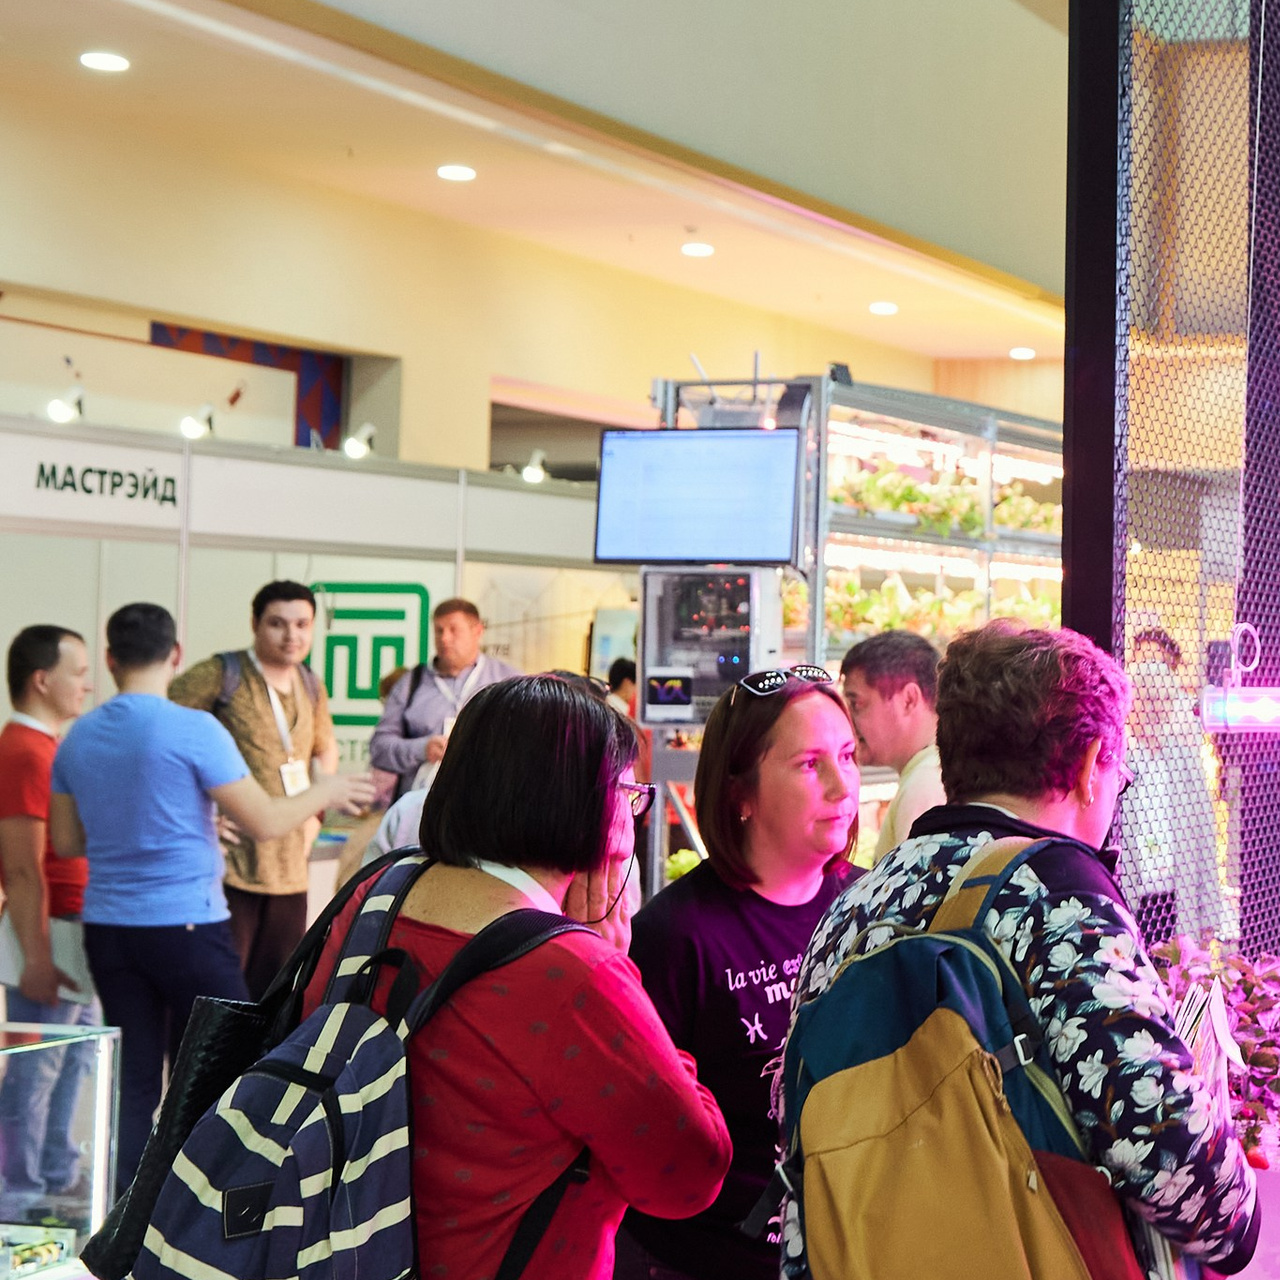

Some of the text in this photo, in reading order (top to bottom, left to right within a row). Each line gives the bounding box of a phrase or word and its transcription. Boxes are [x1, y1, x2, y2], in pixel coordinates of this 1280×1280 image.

[36, 461, 177, 507] МАСТРЭЙД
[725, 968, 747, 991] la
[748, 960, 778, 985] vie
